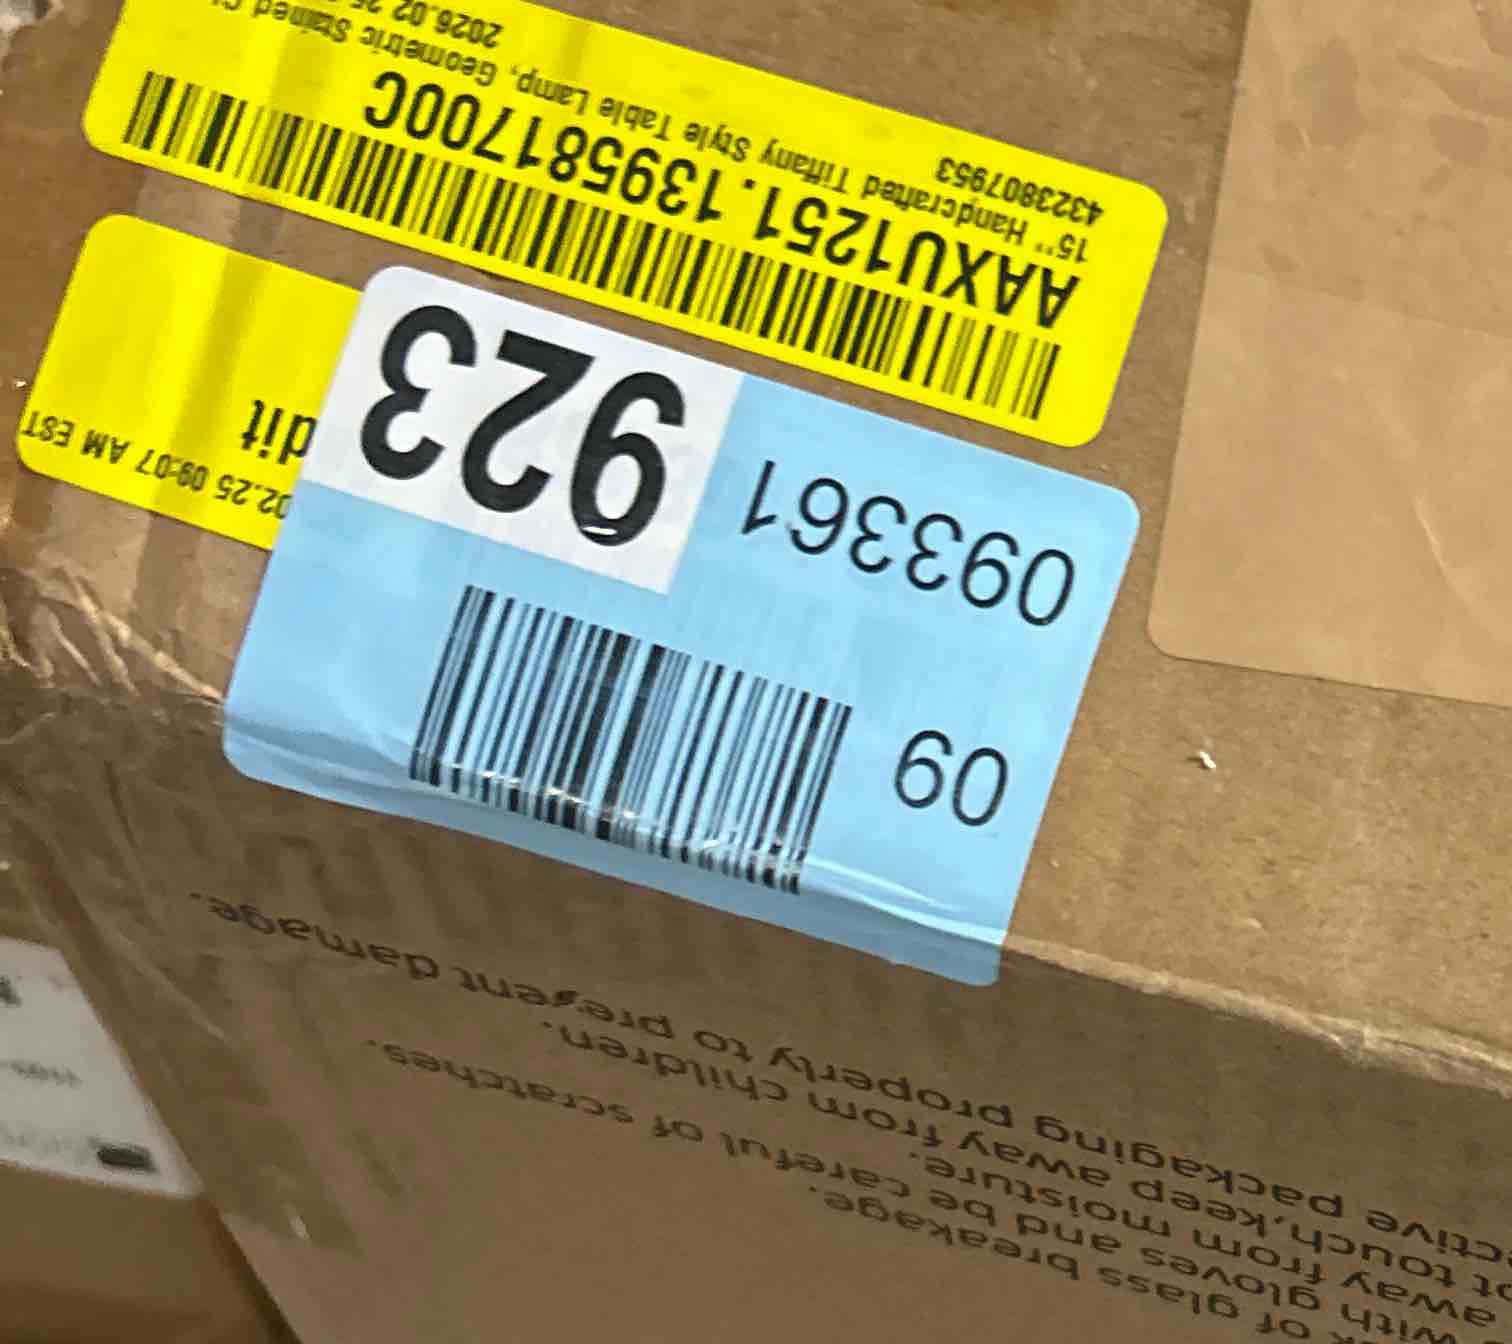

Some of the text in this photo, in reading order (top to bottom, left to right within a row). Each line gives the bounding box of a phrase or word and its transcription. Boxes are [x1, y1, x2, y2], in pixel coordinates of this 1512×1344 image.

[358, 24, 499, 89] Geometric
[509, 64, 592, 114] Lamp,
[597, 96, 673, 140] Table
[682, 118, 752, 164] Style
[757, 137, 851, 193] Tiffany
[363, 70, 1082, 330] AAXU1251.139581700C
[859, 173, 1030, 246] Handcrafted
[934, 155, 1105, 228] 4323807953
[20, 410, 76, 449] EST
[80, 428, 132, 465] AM
[359, 303, 686, 548] 923
[134, 448, 211, 493] 09:07
[740, 459, 1076, 628] 093361
[892, 728, 1009, 828] 09
[188, 891, 441, 982] damage.
[540, 1020, 790, 1103] children.
[691, 1028, 753, 1063] to
[365, 1038, 636, 1125] scratches.
[767, 1045, 1015, 1130] properly
[651, 1114, 705, 1145] of
[806, 1090, 944, 1149] from
[718, 1130, 912, 1200] careful
[956, 1129, 1112, 1189] away
[1033, 1114, 1345, 1220] packaging
[908, 1151, 1172, 1239] moisture.
[927, 1187, 998, 1227] be
[807, 1185, 1081, 1282] breakage.
[1014, 1211, 1123, 1256] and
[1191, 1227, 1327, 1287] from
[1096, 1265, 1241, 1320] glass
[1139, 1246, 1322, 1312] gloves
[1339, 1269, 1497, 1329] away
[1254, 1311, 1312, 1344] of
